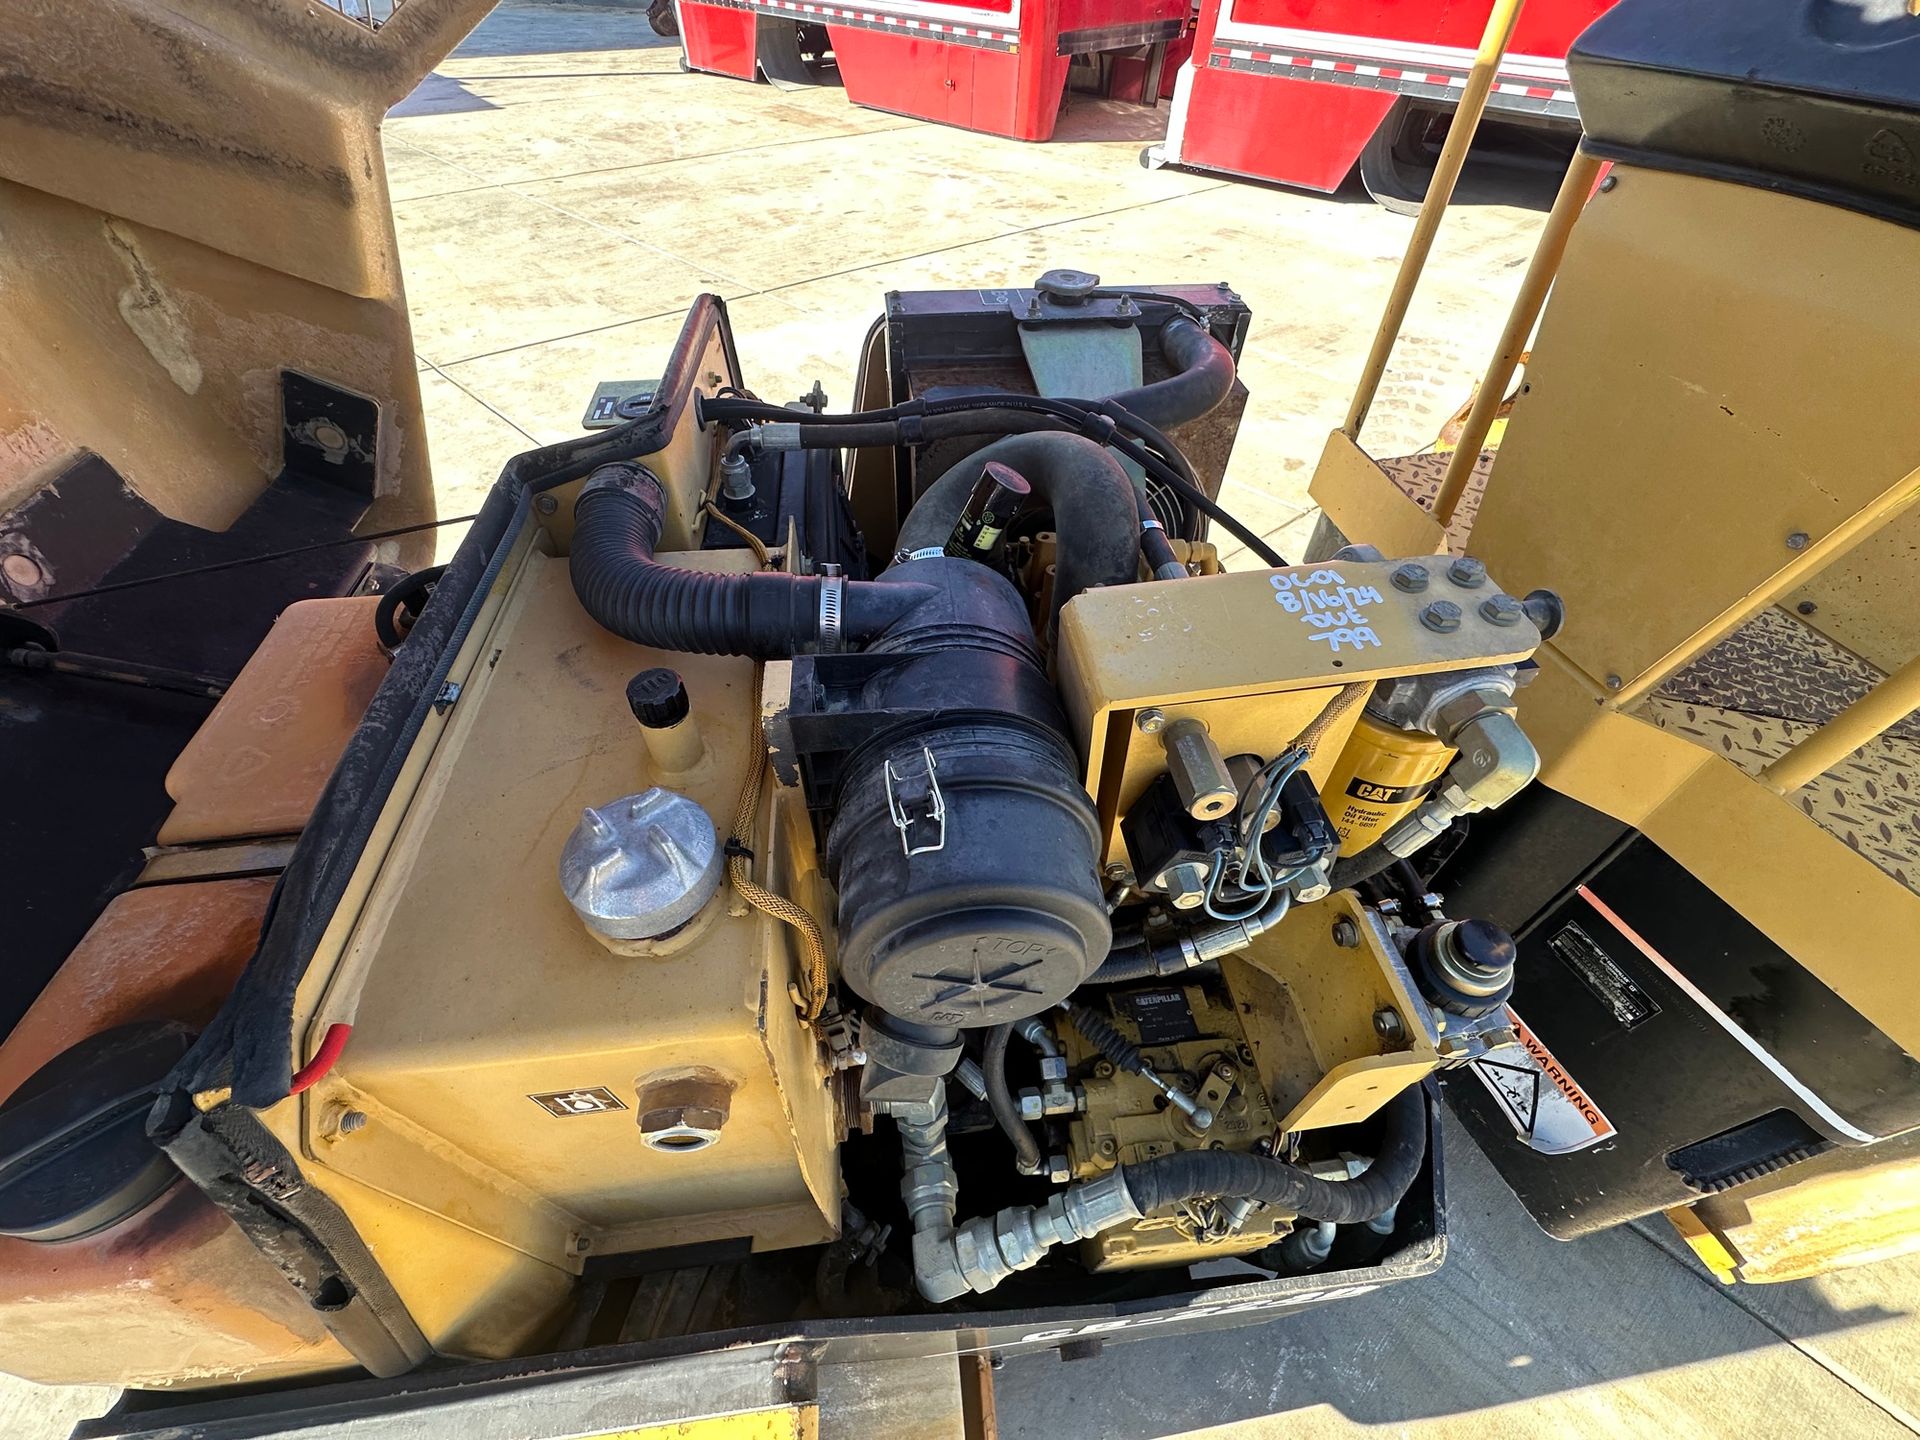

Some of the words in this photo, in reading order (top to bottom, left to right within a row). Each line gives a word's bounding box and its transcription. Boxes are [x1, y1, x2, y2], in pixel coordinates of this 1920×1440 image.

[1275, 586, 1384, 614] 8/16/24
[1301, 609, 1369, 628] DUE
[1308, 626, 1382, 652] 799
[1357, 784, 1396, 802] CAT
[1347, 805, 1387, 817] Hydraulic
[1357, 814, 1380, 823] Filter
[1135, 993, 1181, 1006] CATERPILLAR
[1526, 1038, 1599, 1125] WARNING
